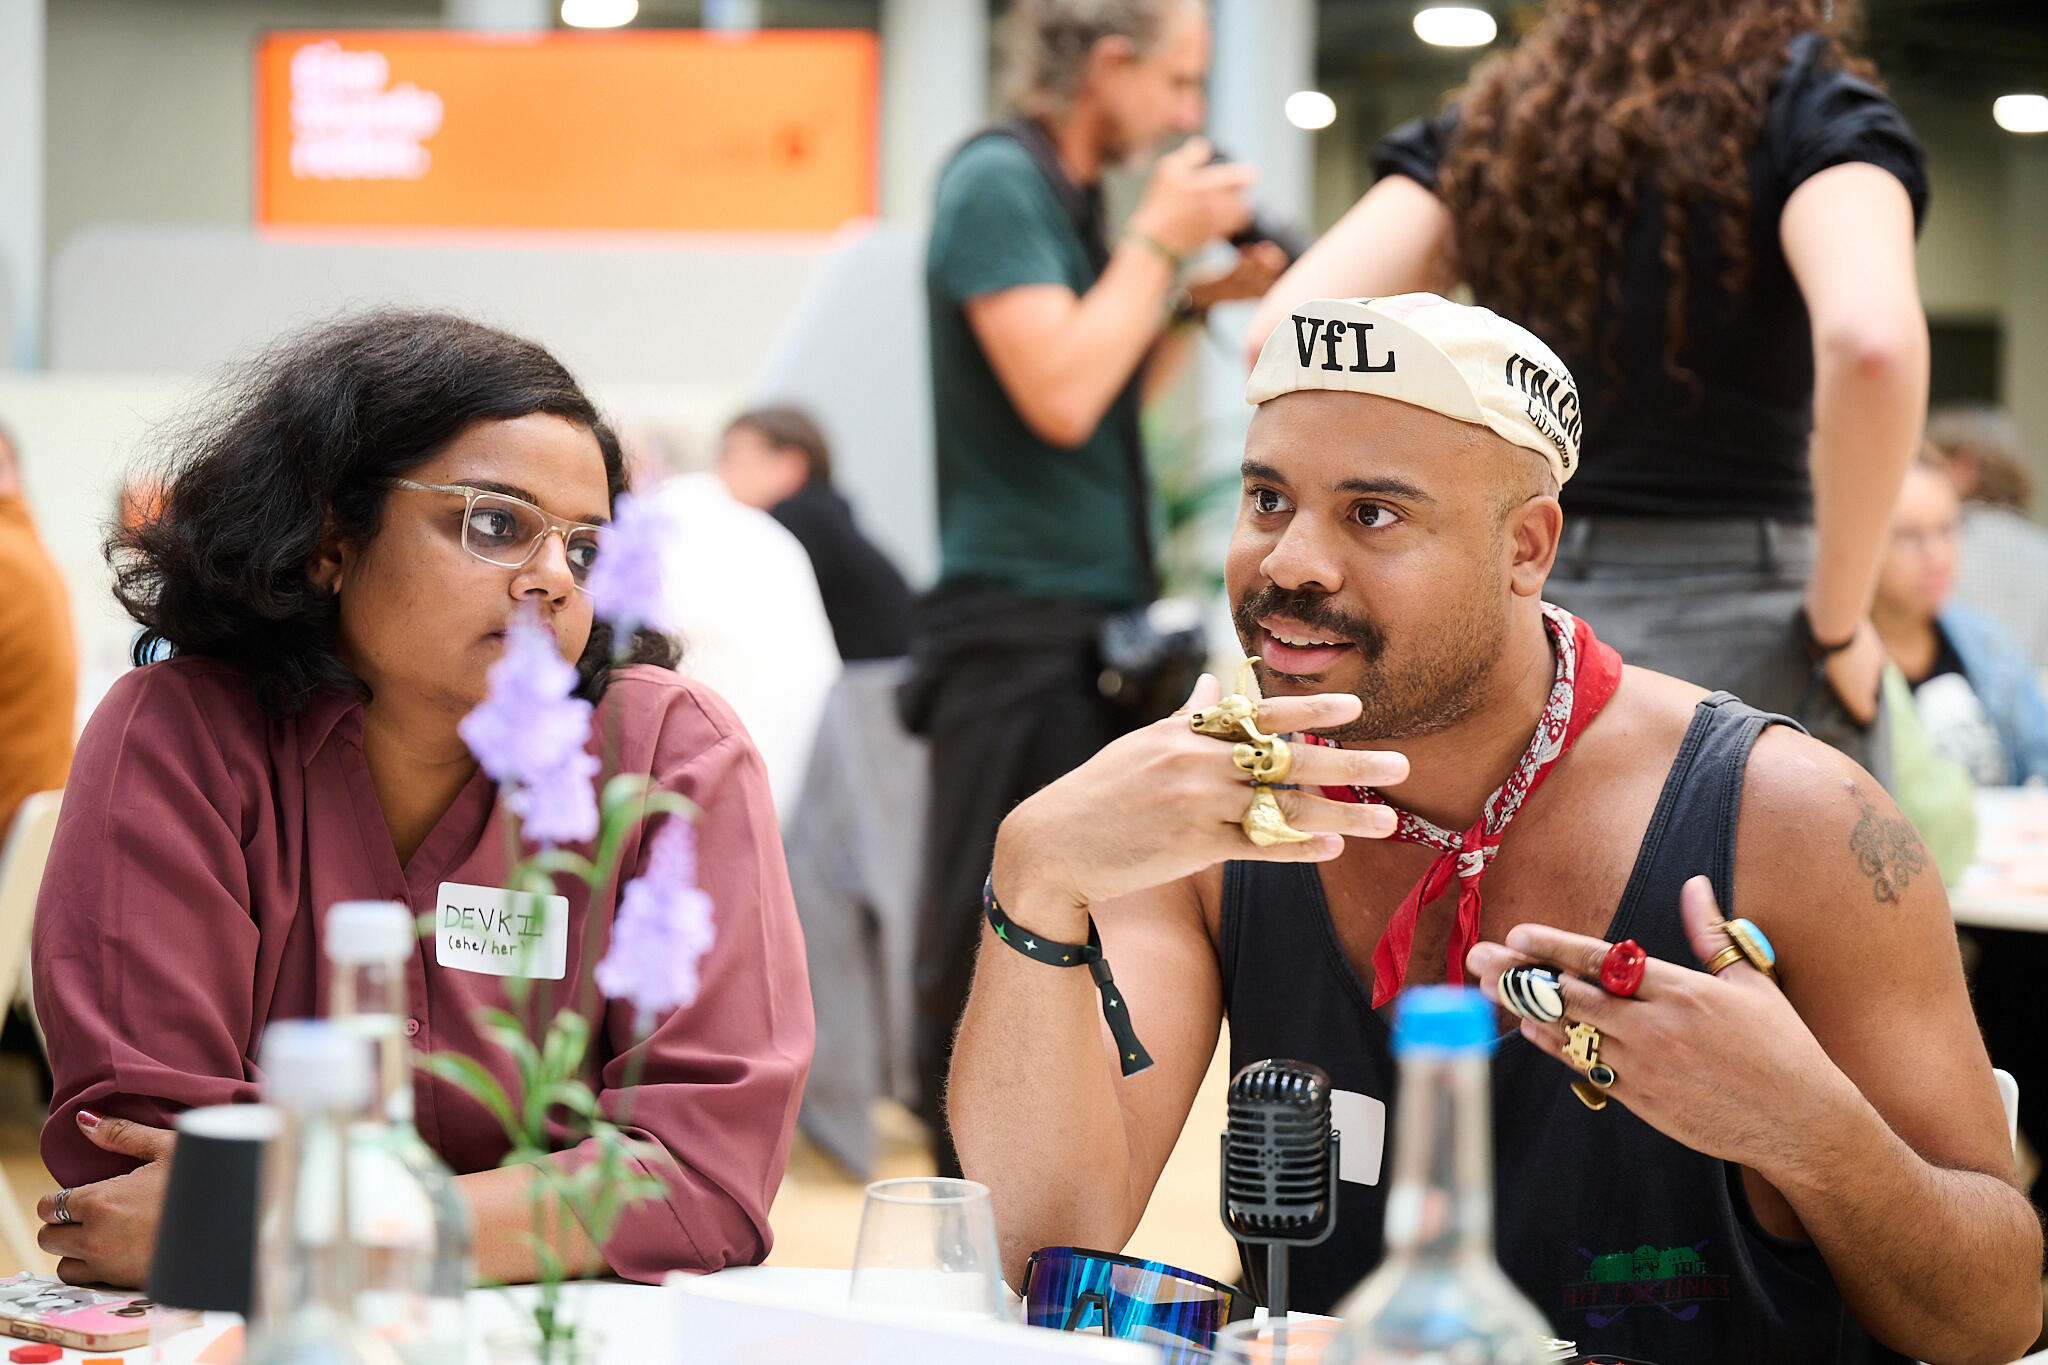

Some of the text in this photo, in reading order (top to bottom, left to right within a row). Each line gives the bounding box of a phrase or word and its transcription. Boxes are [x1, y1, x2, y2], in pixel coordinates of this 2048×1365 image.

[1291, 314, 1396, 373] VfL
[444, 904, 543, 937] DEVKI
[1562, 1276, 1730, 1307] HIT THE LINKS
